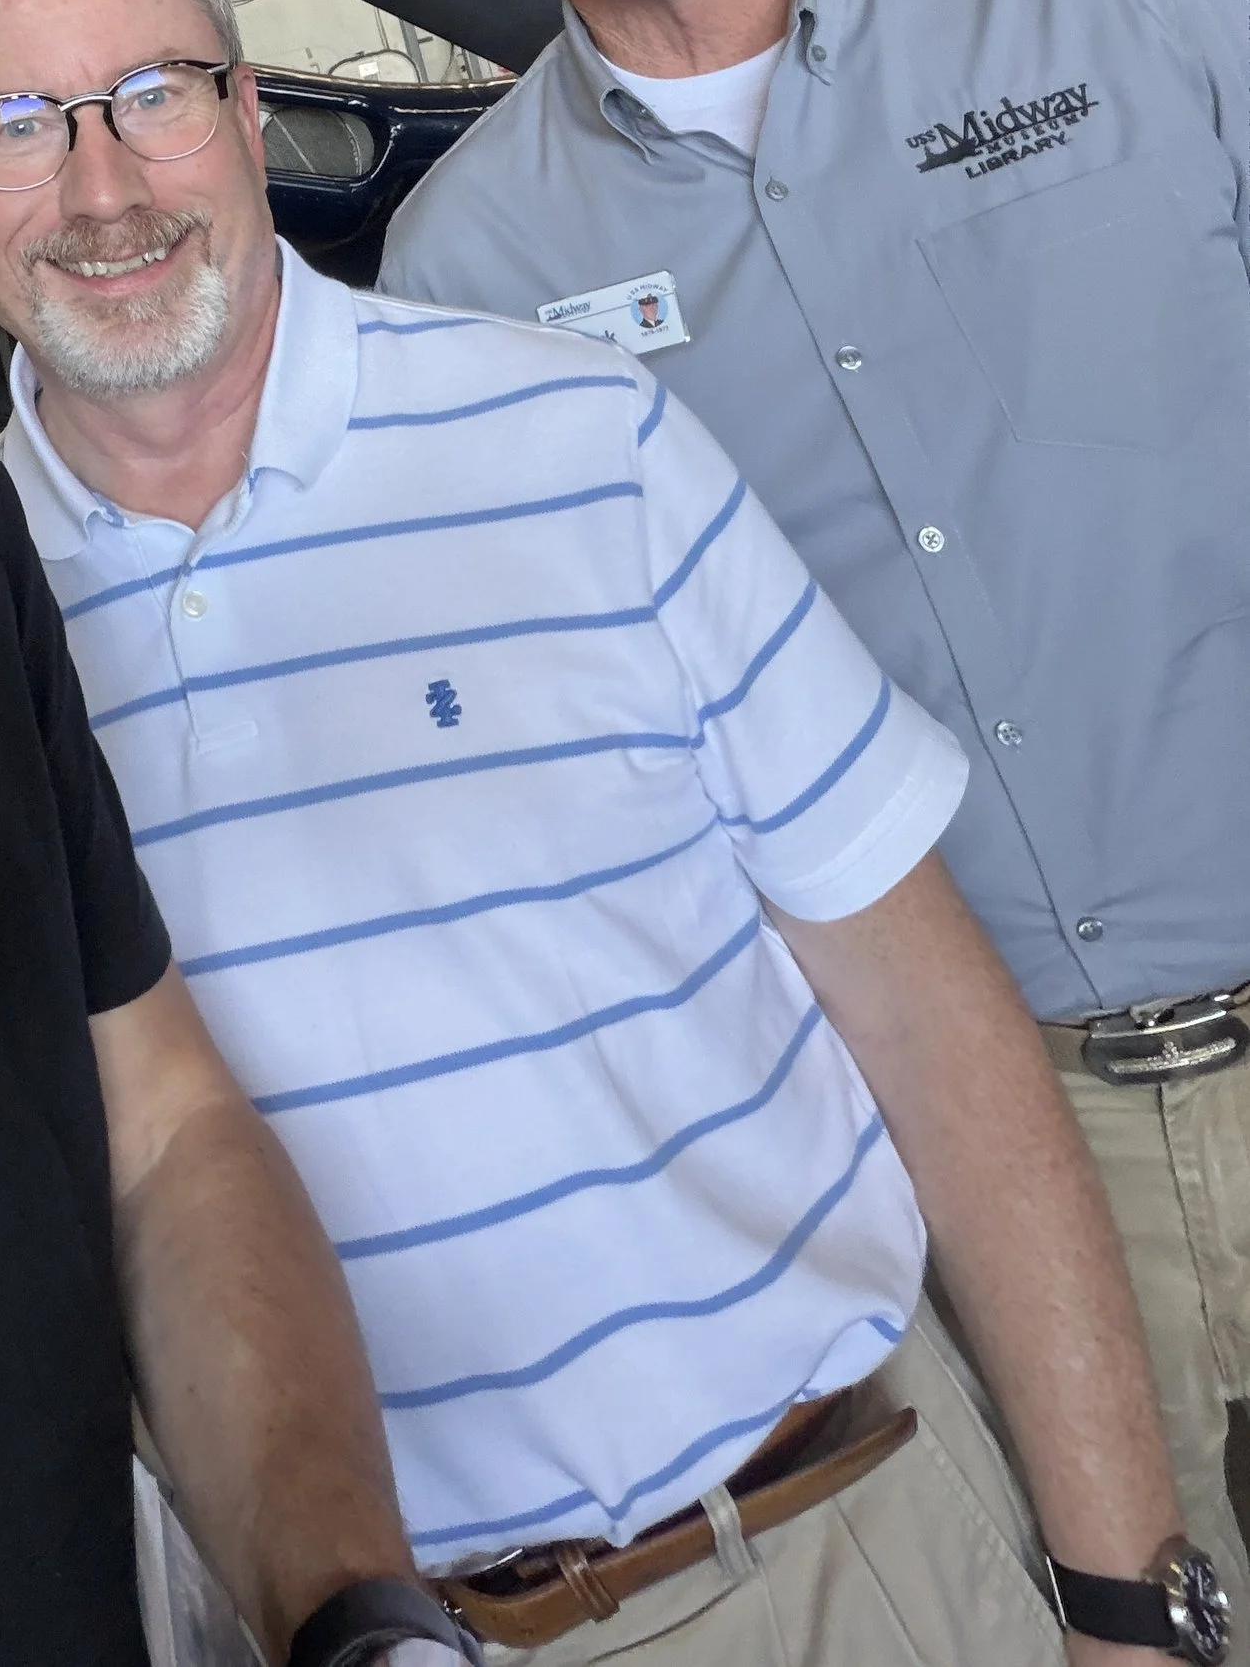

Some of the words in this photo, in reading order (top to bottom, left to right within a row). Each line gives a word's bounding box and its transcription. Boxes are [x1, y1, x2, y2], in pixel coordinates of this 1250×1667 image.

[905, 129, 937, 149] USS
[933, 83, 1089, 151] Midway
[987, 114, 1080, 154] MUSEUM
[964, 131, 1067, 179] LIBRARY
[639, 282, 669, 293] MIDWAY
[552, 300, 591, 317] Midway
